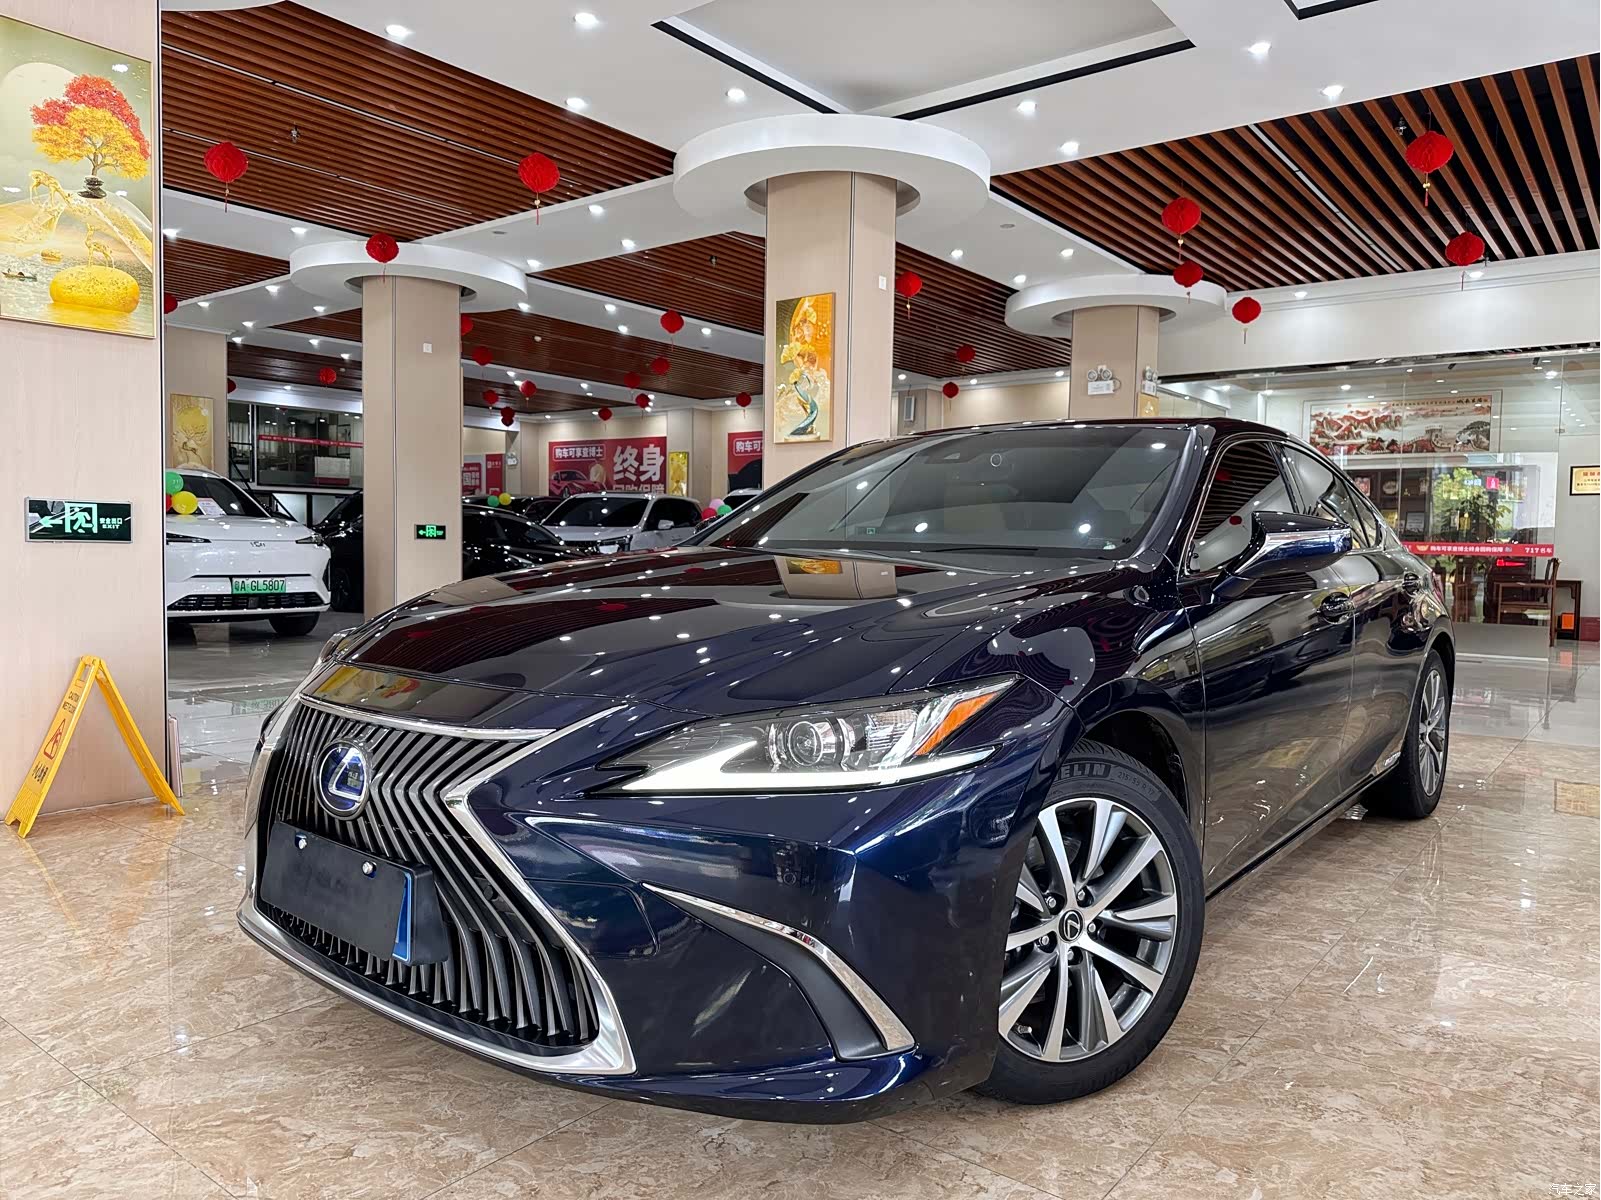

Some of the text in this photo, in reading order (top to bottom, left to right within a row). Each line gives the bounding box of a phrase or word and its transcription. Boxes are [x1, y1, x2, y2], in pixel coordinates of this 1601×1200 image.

[555, 446, 603, 459] 购车可享查博士
[613, 444, 665, 482] 终身
[250, 579, 285, 592] GL5807
[1059, 763, 1106, 779] ELIN
